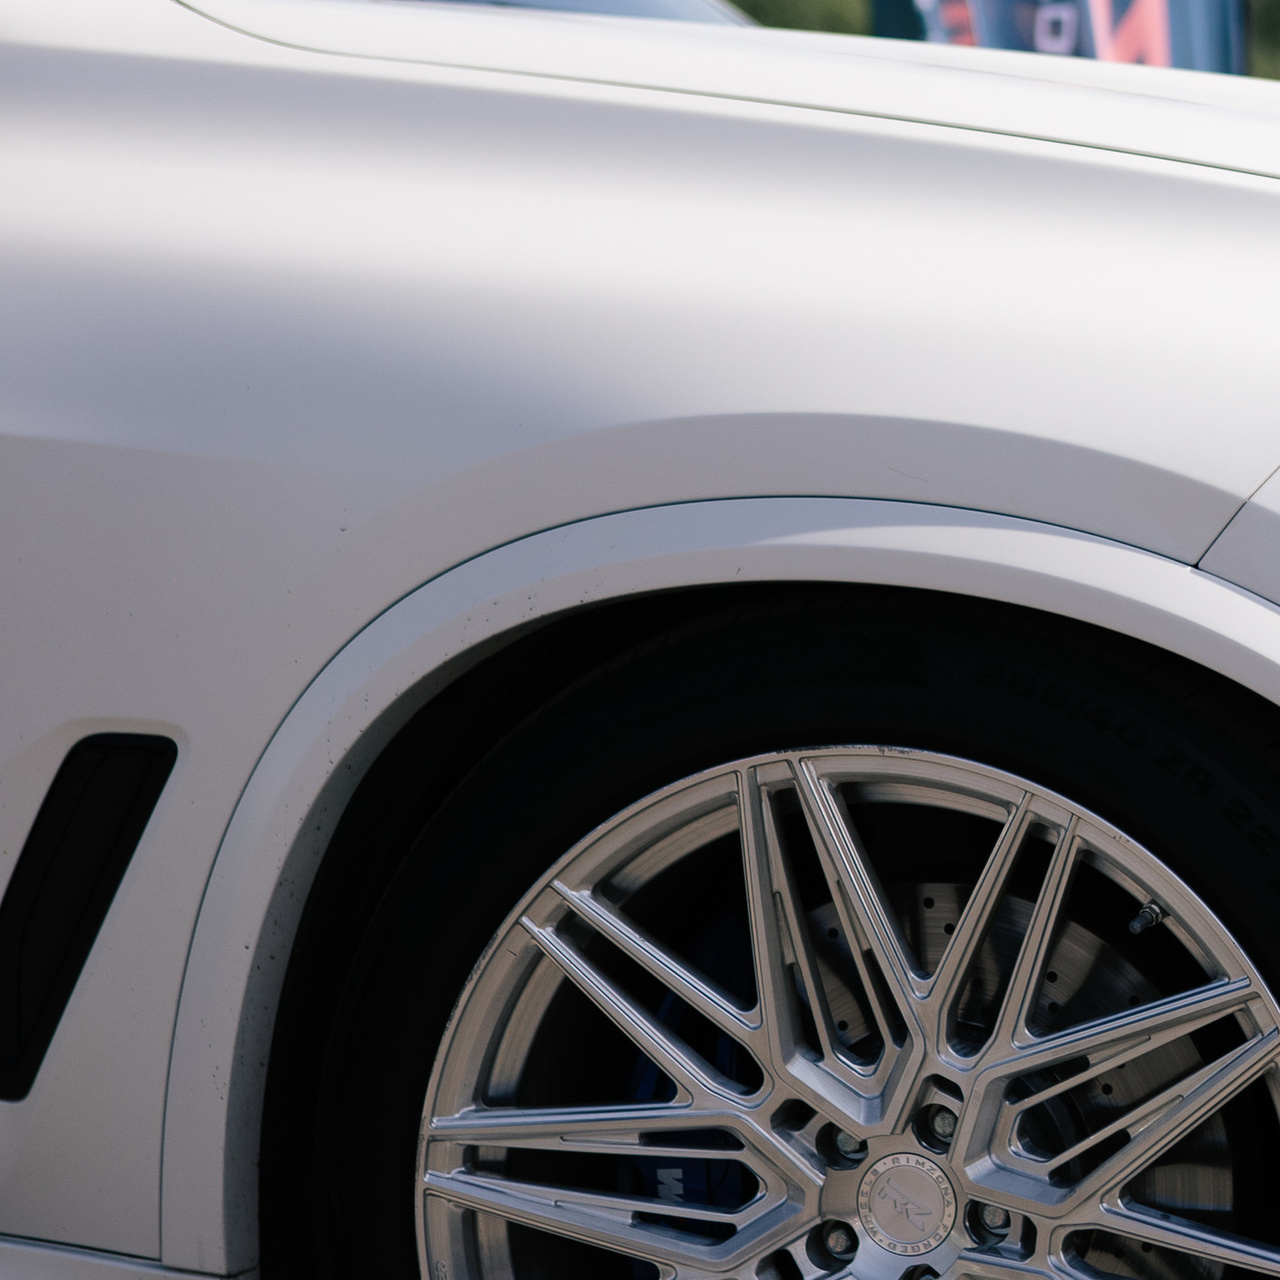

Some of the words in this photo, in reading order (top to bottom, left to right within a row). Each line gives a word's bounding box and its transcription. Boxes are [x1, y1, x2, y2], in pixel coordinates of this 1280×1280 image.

[970, 660, 1148, 749] 285/40
[1154, 742, 1220, 801] ZR
[859, 1168, 881, 1238] WHEELS
[891, 1156, 954, 1209] RIMZONA
[887, 1221, 950, 1254] FORGED
